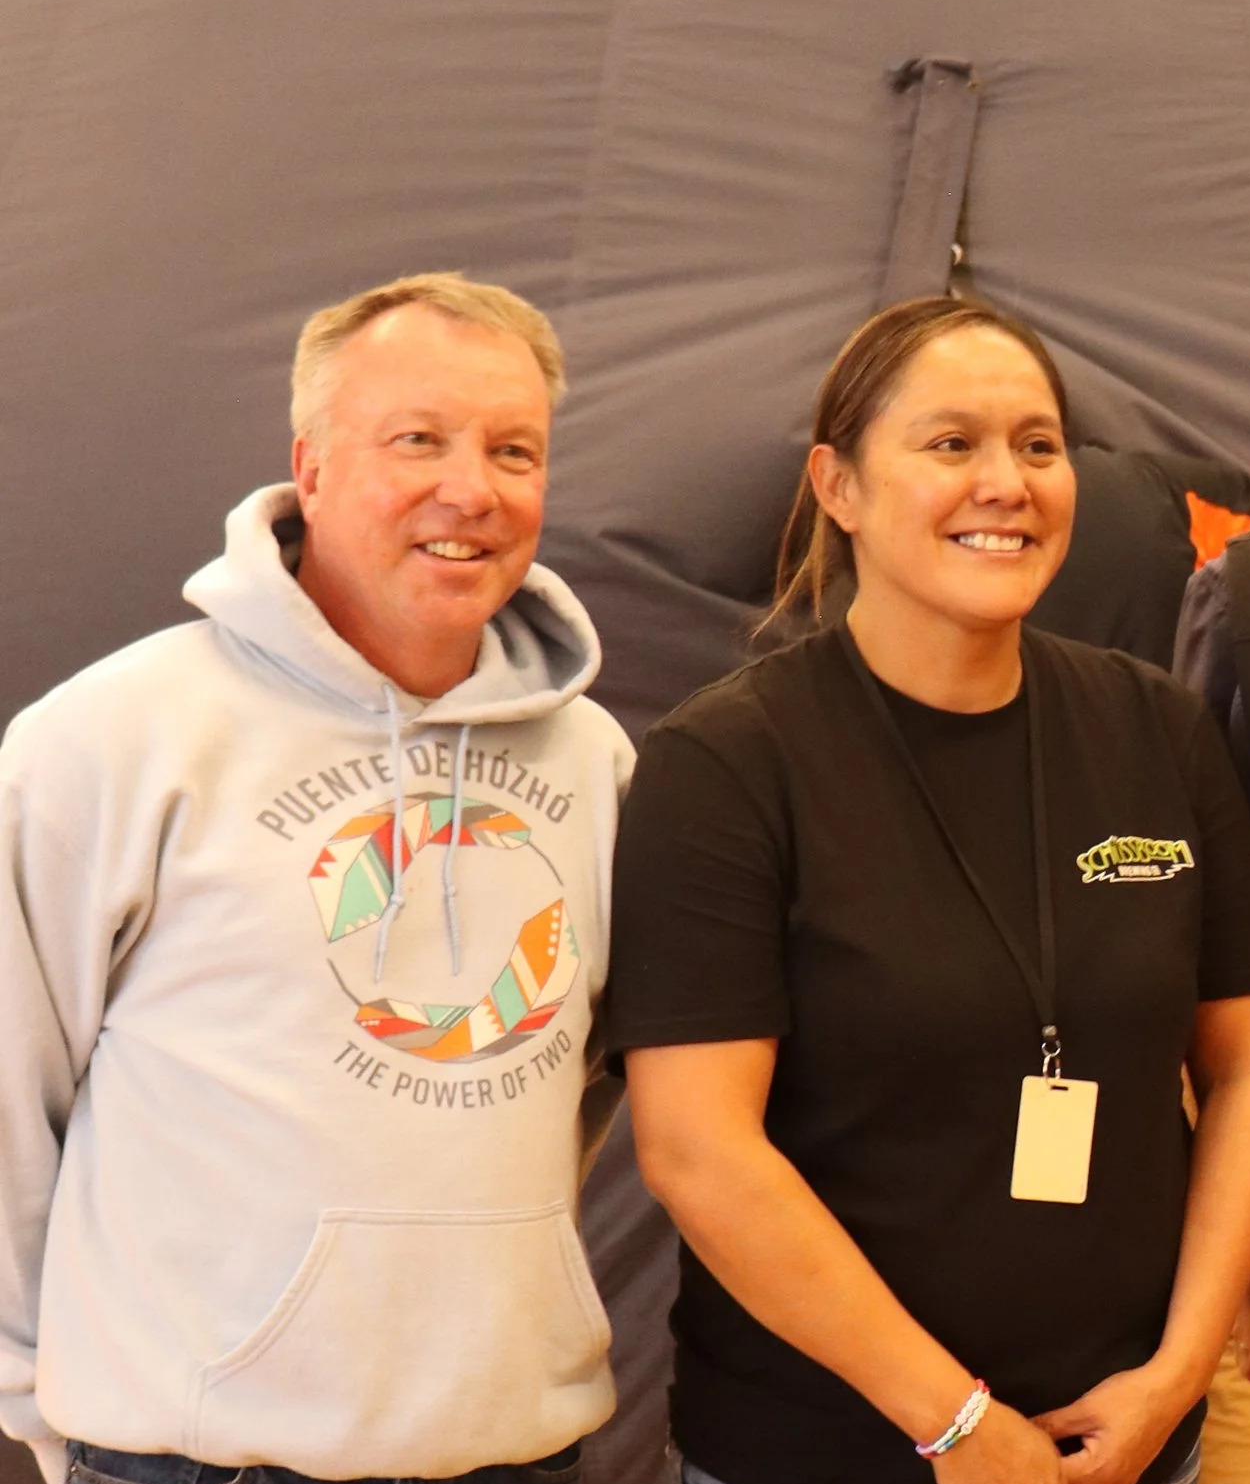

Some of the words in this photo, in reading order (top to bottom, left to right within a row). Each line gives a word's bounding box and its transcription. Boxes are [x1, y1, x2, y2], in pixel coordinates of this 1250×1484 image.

[256, 754, 396, 842] PUENTE
[407, 741, 451, 777] DE
[464, 748, 576, 825] HÓZHÓ
[333, 1041, 390, 1090] THE
[392, 1071, 496, 1109] POWER
[503, 1069, 528, 1101] OF
[532, 1029, 573, 1081] TWO
